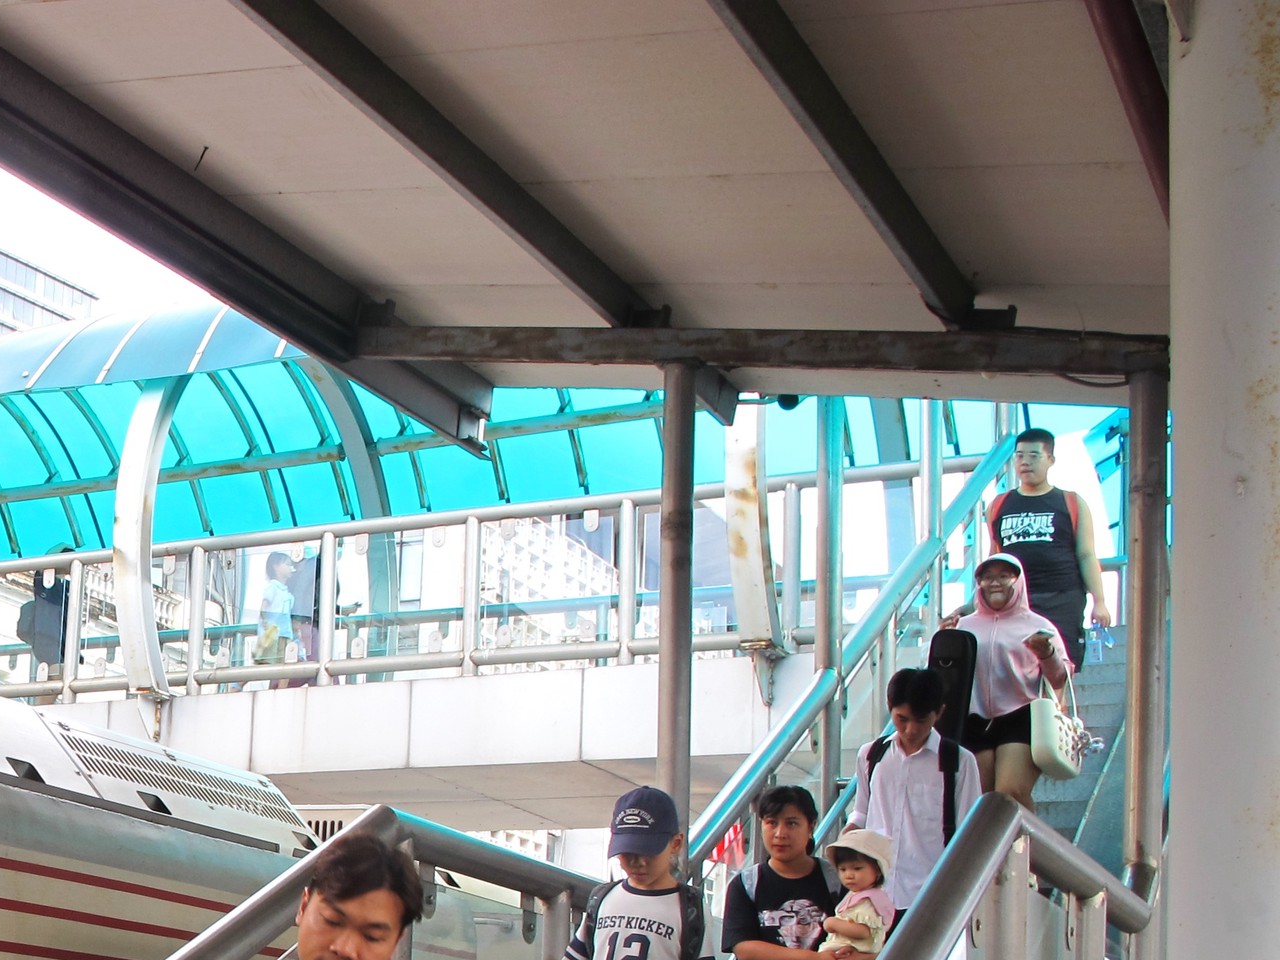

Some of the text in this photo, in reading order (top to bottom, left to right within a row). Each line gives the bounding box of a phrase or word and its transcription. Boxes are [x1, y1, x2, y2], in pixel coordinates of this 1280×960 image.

[639, 810, 654, 824] YORK
[597, 915, 674, 940] BEST KICKER
